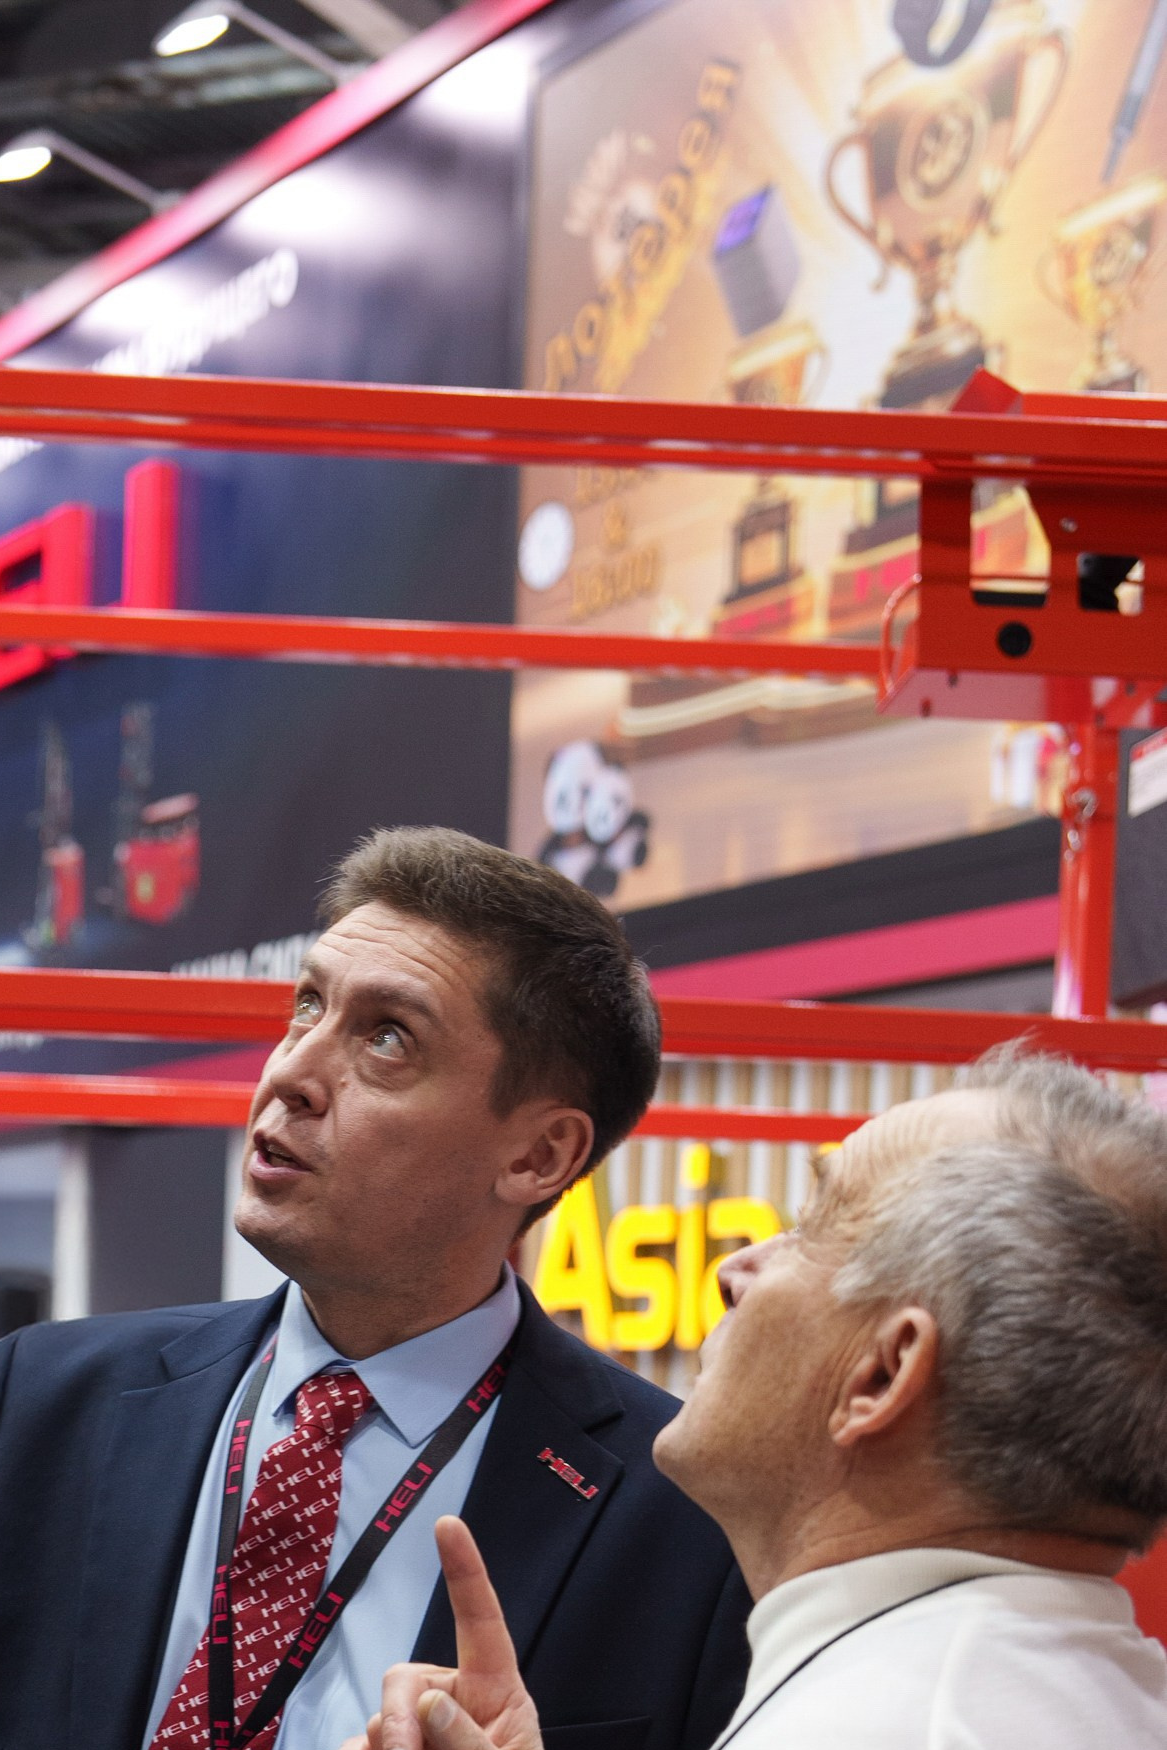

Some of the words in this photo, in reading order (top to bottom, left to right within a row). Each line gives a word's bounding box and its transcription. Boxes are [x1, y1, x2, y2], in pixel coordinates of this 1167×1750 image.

[225, 1419, 252, 1495] HELI
[262, 1429, 310, 1462] HELI
[301, 1435, 336, 1458] HEL
[256, 1463, 283, 1488] ELI
[277, 1460, 324, 1492] HELI
[536, 1447, 600, 1499] HELI
[252, 1493, 299, 1525] HELI
[375, 1461, 433, 1532] HELI
[234, 1528, 276, 1557] HELI
[270, 1524, 317, 1555] HELI
[248, 1556, 294, 1587] HELI
[286, 1556, 329, 1586] HEL
[212, 1564, 230, 1644] HELI
[261, 1587, 308, 1618] HELI
[235, 1620, 281, 1650] HELI
[274, 1625, 304, 1649] HE
[288, 1591, 344, 1669] HELI
[178, 1692, 209, 1712] HE
[153, 1715, 200, 1743] HELI
